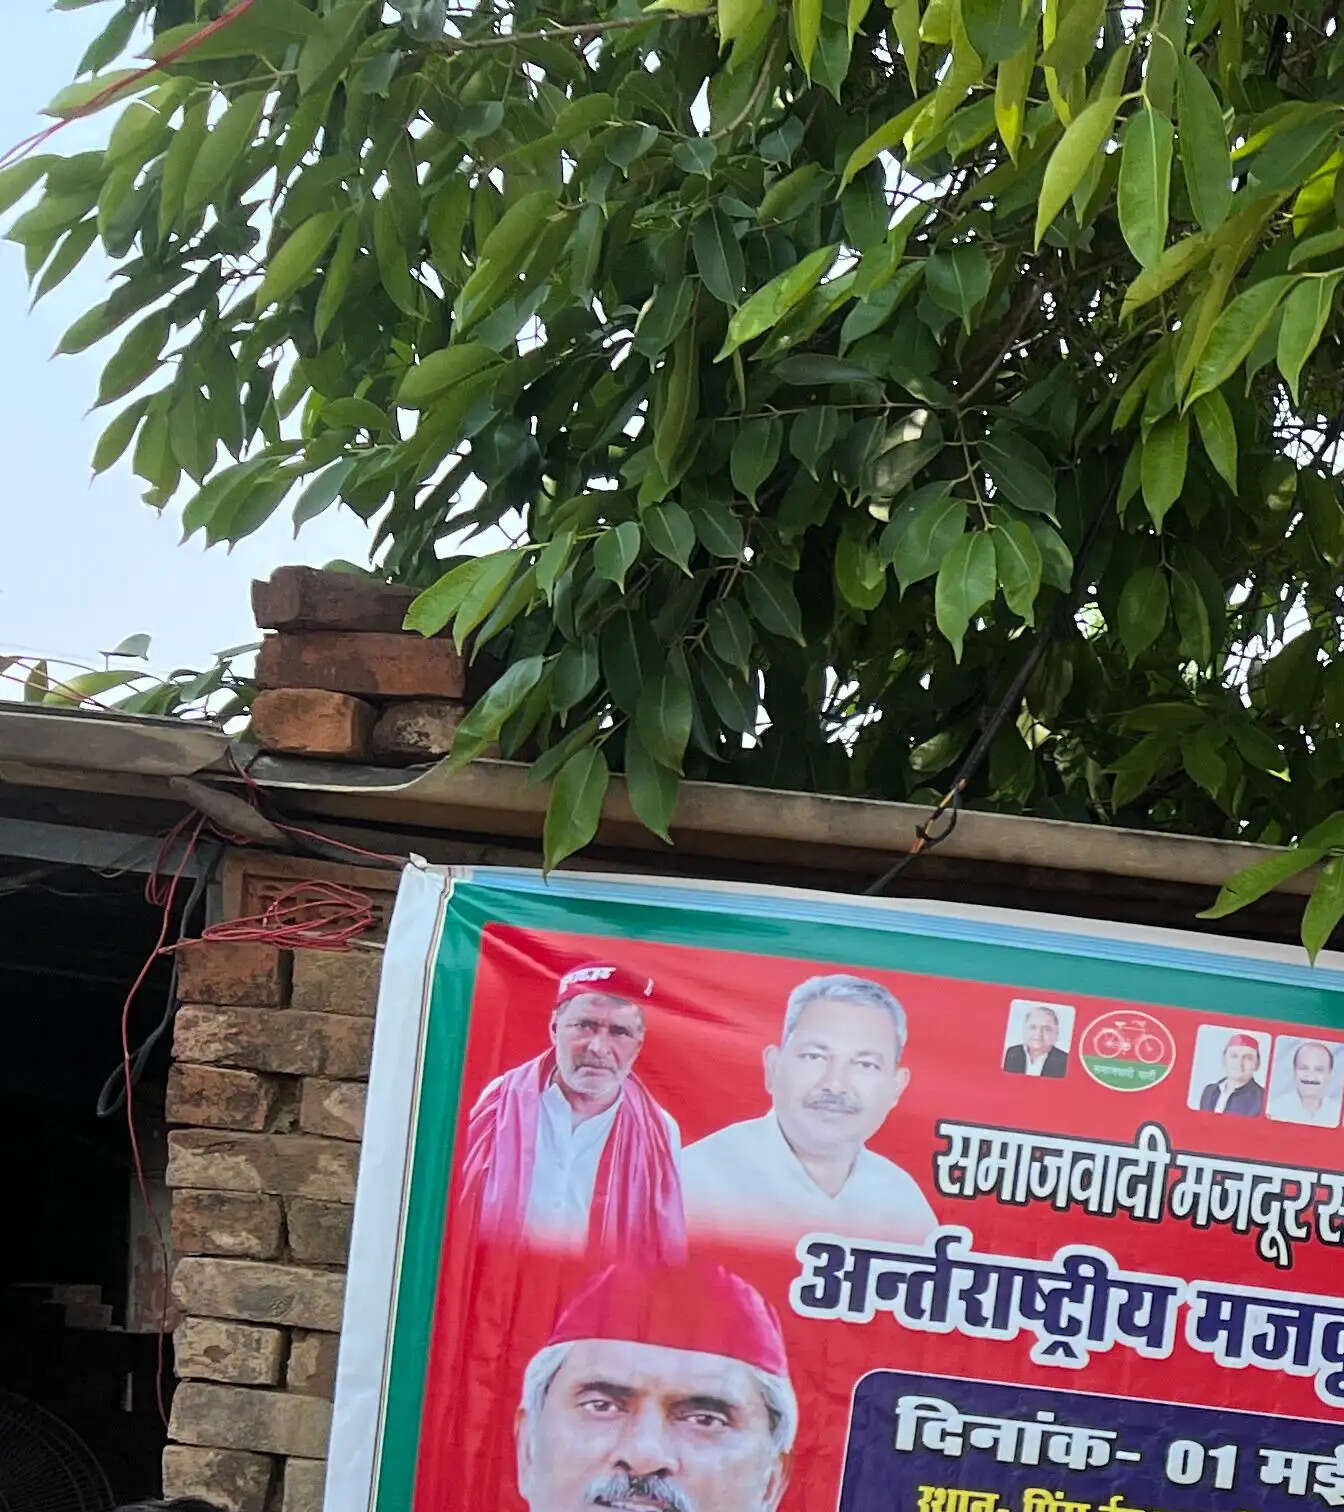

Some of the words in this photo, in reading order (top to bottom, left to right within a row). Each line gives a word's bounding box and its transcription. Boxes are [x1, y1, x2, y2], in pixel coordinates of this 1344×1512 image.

[936, 1123, 1171, 1220] समाजवादी
[1172, 1154, 1317, 1266] मजदूर
[895, 1395, 1141, 1471] दिनांक-
[1165, 1439, 1238, 1490] 01
